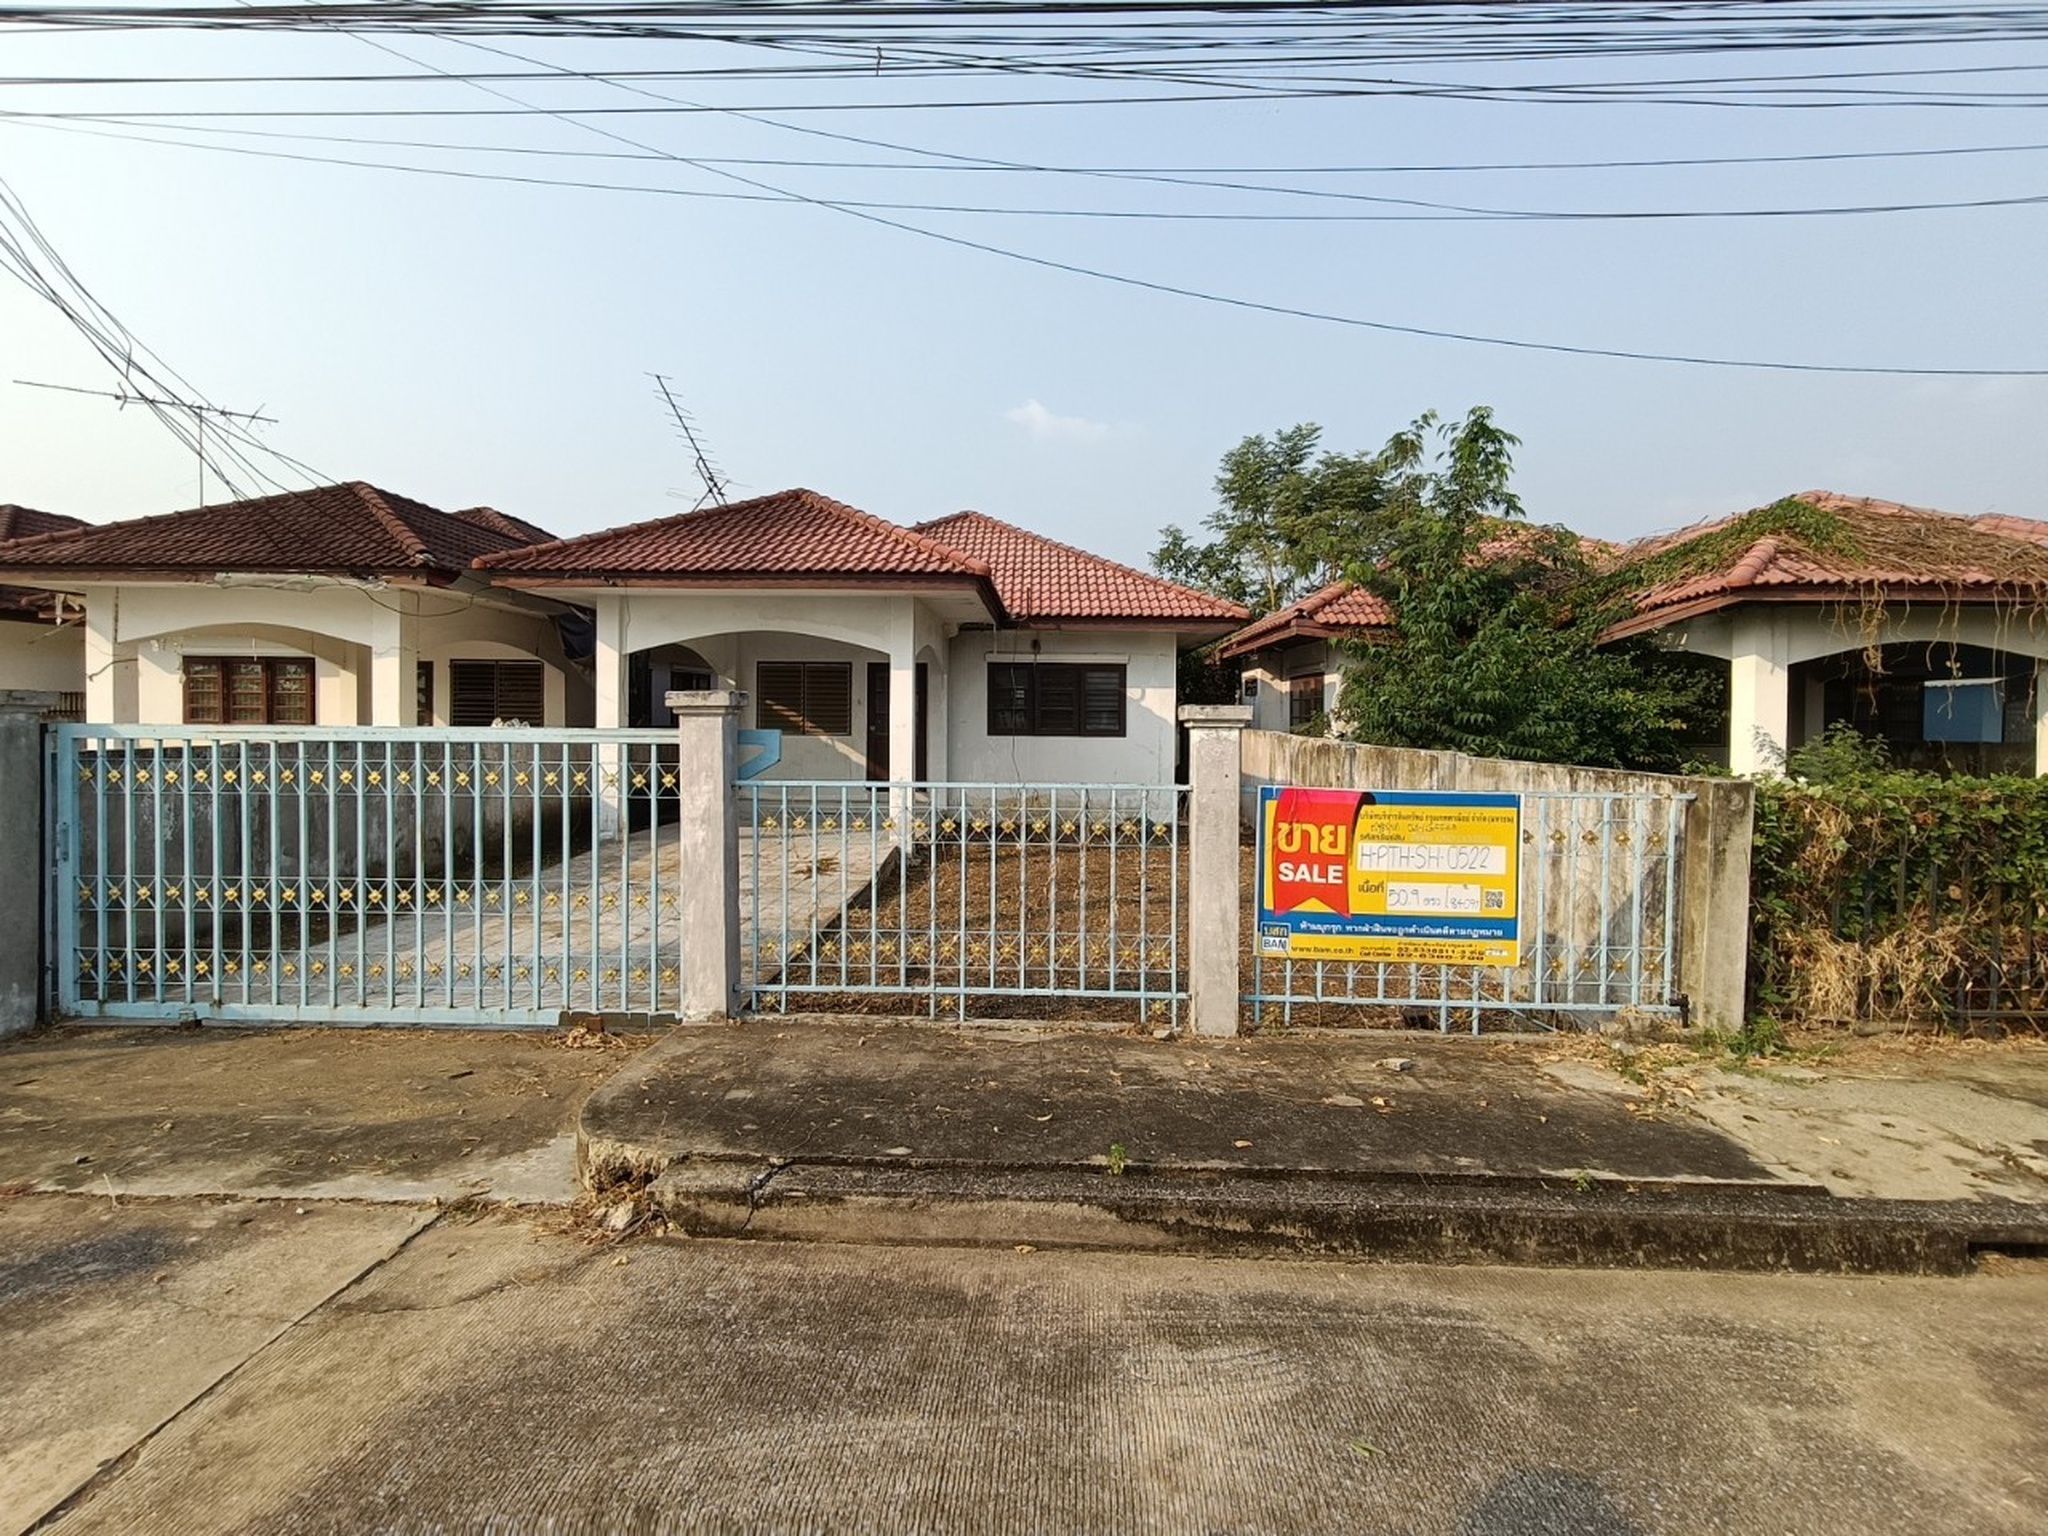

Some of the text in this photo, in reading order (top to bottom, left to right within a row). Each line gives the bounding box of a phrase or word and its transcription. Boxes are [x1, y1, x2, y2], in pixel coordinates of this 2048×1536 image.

[1277, 822, 1347, 855] ขาย
[1277, 862, 1344, 885] SALE
[1358, 880, 1385, 894] เนื้อที่
